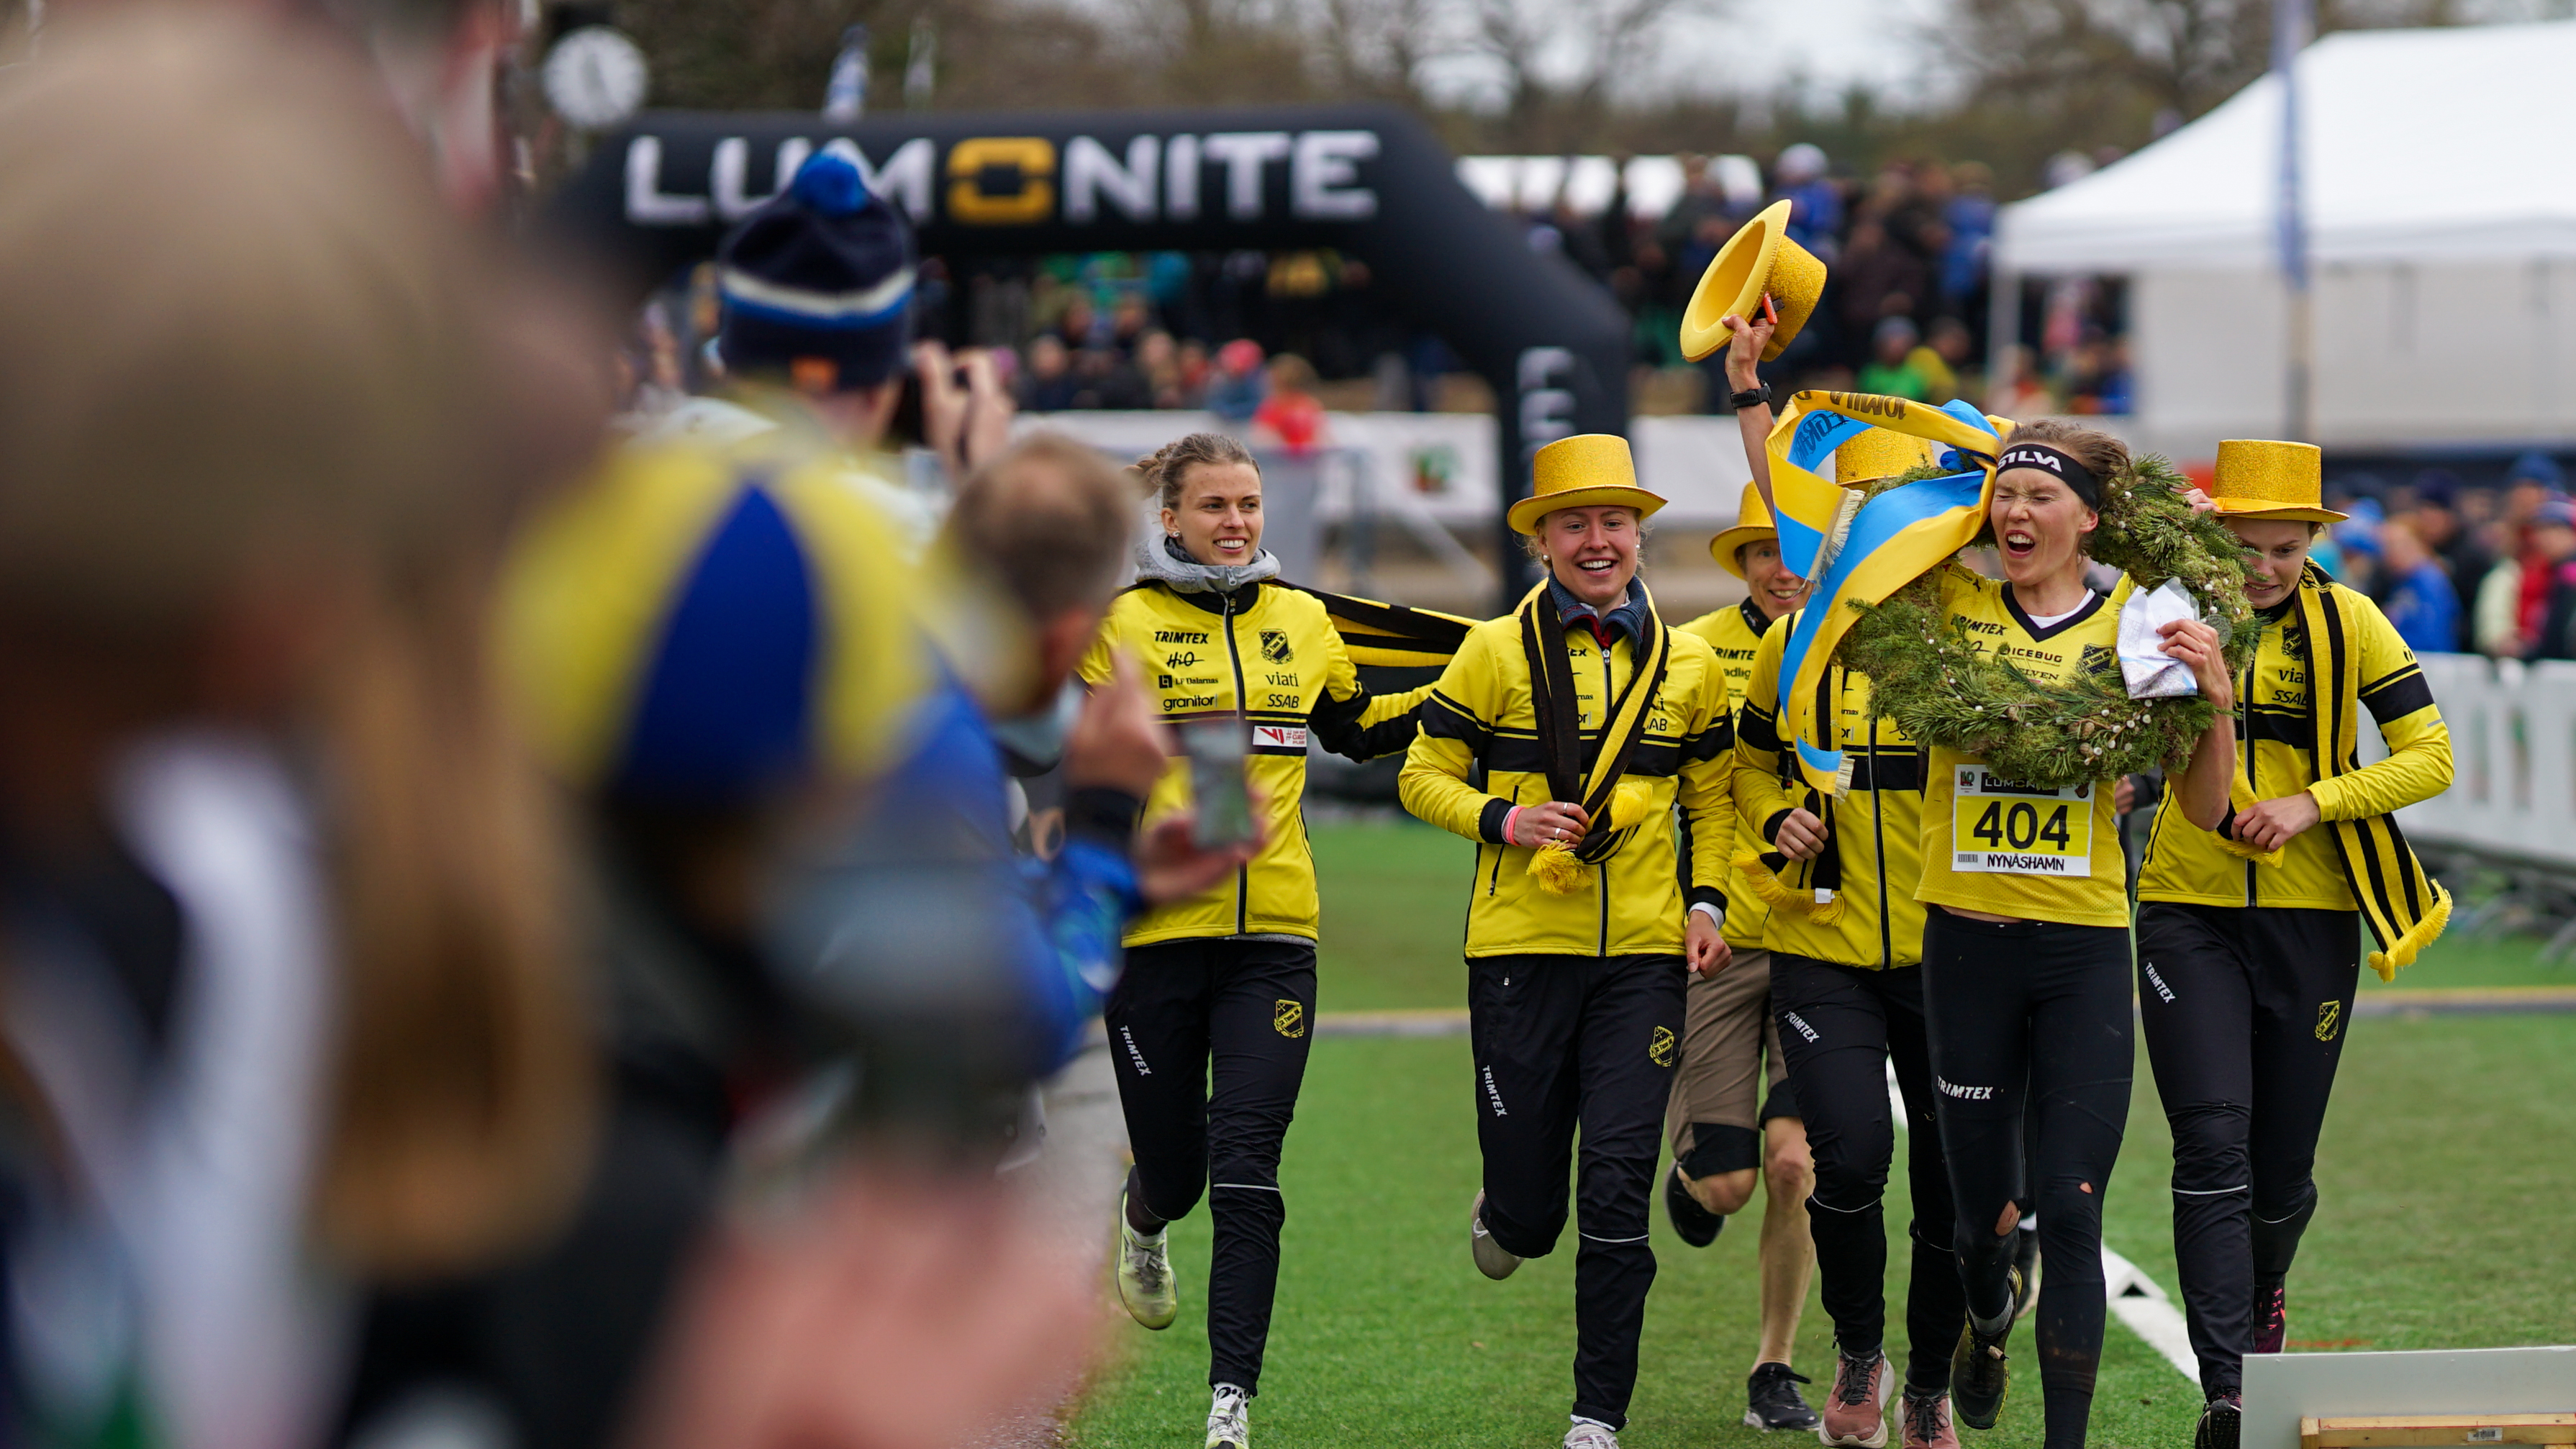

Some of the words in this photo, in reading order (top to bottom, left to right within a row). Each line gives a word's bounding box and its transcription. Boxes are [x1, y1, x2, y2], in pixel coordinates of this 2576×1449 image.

[1997, 450, 2062, 473] SILVA
[1154, 631, 1210, 644] TRIMTEX
[2012, 647, 2063, 663] ICEBUG
[1266, 672, 1300, 687] viati
[1164, 694, 1215, 712] granitor
[1267, 694, 1300, 709] SSAB
[1973, 801, 2070, 851] 404
[1987, 853, 2065, 871] NYNÄSHAMN
[2144, 962, 2177, 1004] TRIMTEX
[1784, 1011, 1820, 1043] TRIMTEX
[1120, 1025, 1152, 1077] TRIMTEX
[1482, 1065, 1508, 1117] TRIMTEX
[1938, 1075, 1993, 1100] TRIMTEX
